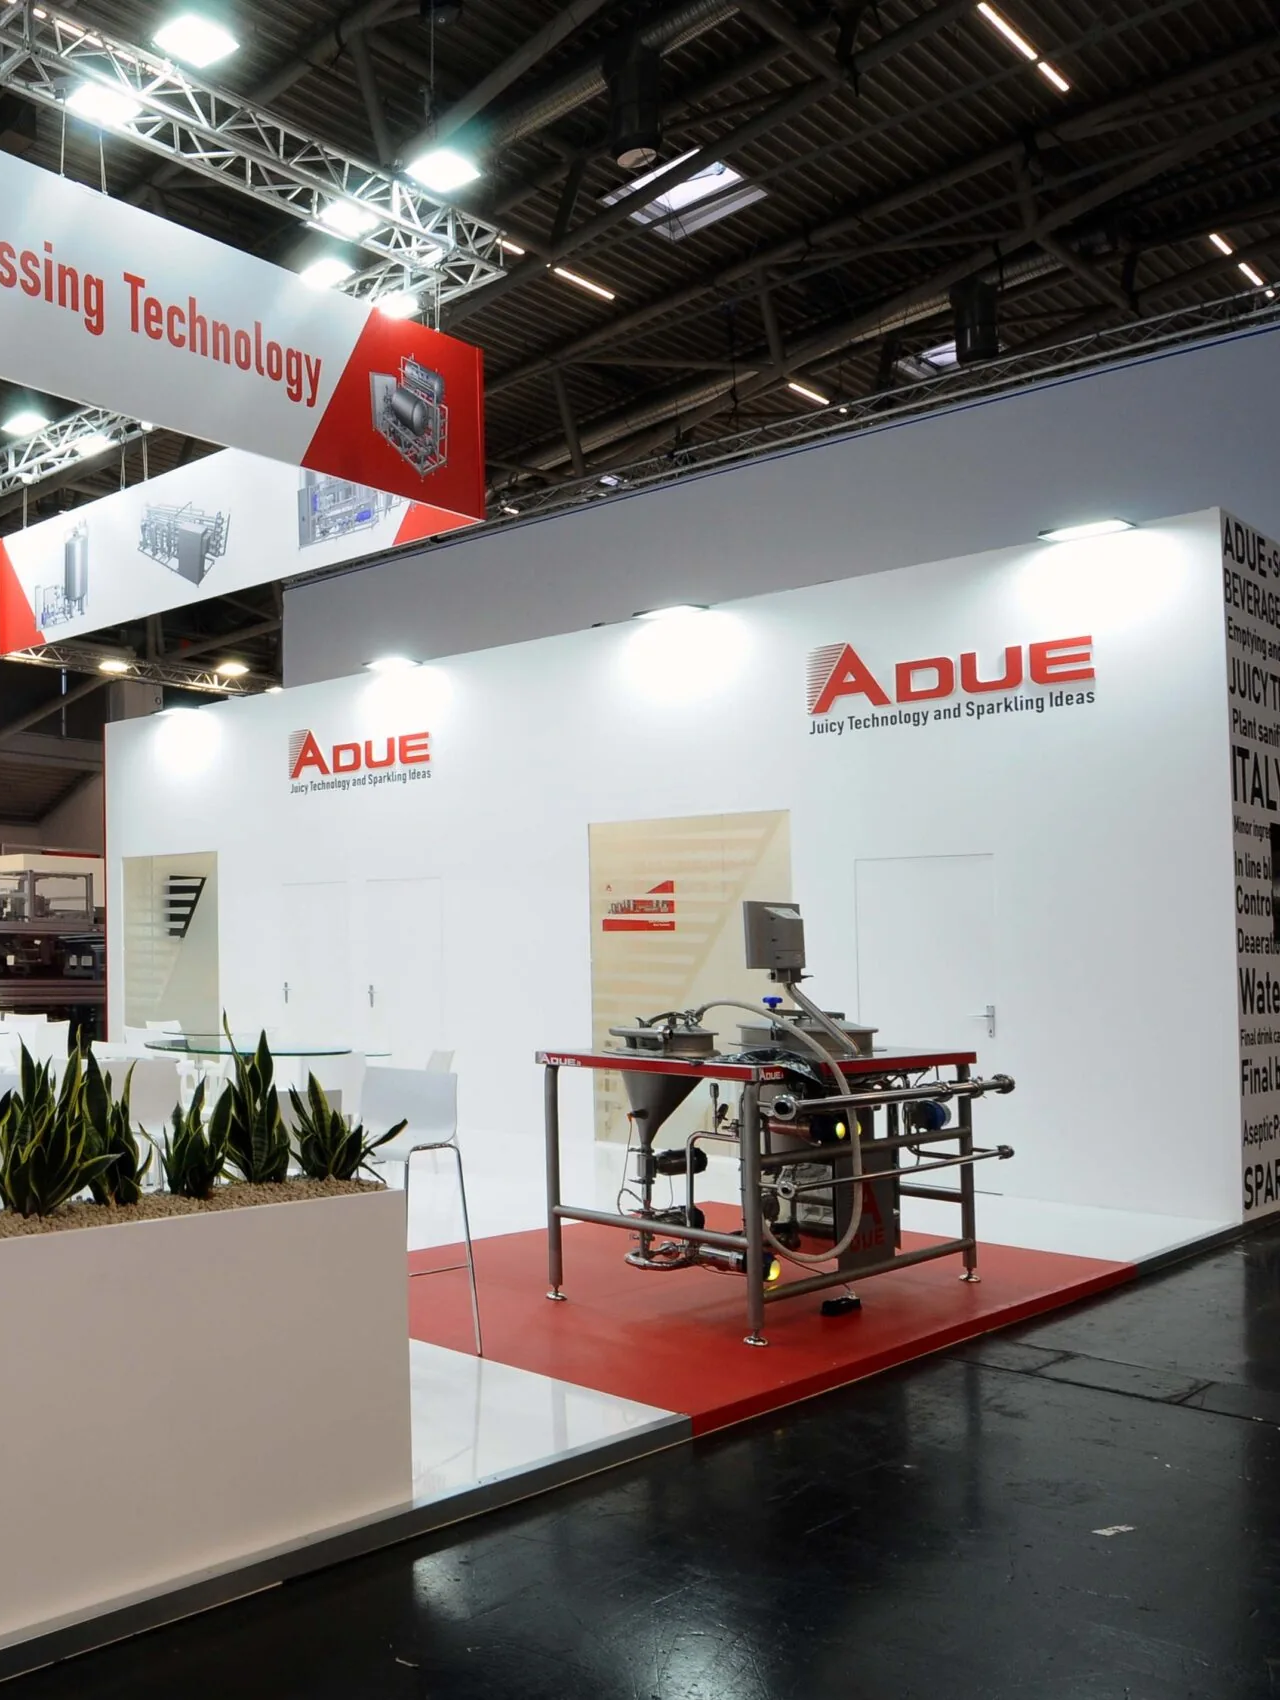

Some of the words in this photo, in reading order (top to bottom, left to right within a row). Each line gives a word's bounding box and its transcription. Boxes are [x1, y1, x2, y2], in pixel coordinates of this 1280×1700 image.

[123, 271, 322, 408] Technology
[1222, 516, 1267, 578] ADUE
[1227, 615, 1267, 660] Emptying
[807, 635, 1096, 715] ADUE
[1229, 656, 1268, 707] JUICY
[809, 719, 845, 736] Juicy
[847, 707, 930, 731] Technology
[933, 702, 962, 721] and
[965, 694, 1045, 720] Sparkling
[1048, 689, 1096, 708] Ideas
[1232, 707, 1257, 740] Plant
[289, 730, 430, 778] ADUE
[290, 783, 309, 795] Juicy
[310, 777, 351, 793] Technology
[352, 774, 366, 787] and
[367, 771, 407, 787] Sparkling
[408, 768, 431, 780] Ideas
[1233, 815, 1252, 836] Minor
[1234, 850, 1244, 876] In
[1244, 852, 1261, 879] line
[1239, 967, 1280, 1016] Wate
[1240, 1028, 1256, 1047] Final
[1257, 1025, 1272, 1046] drink
[1241, 1056, 1272, 1096] Final
[1242, 1113, 1273, 1151] Aseptic
